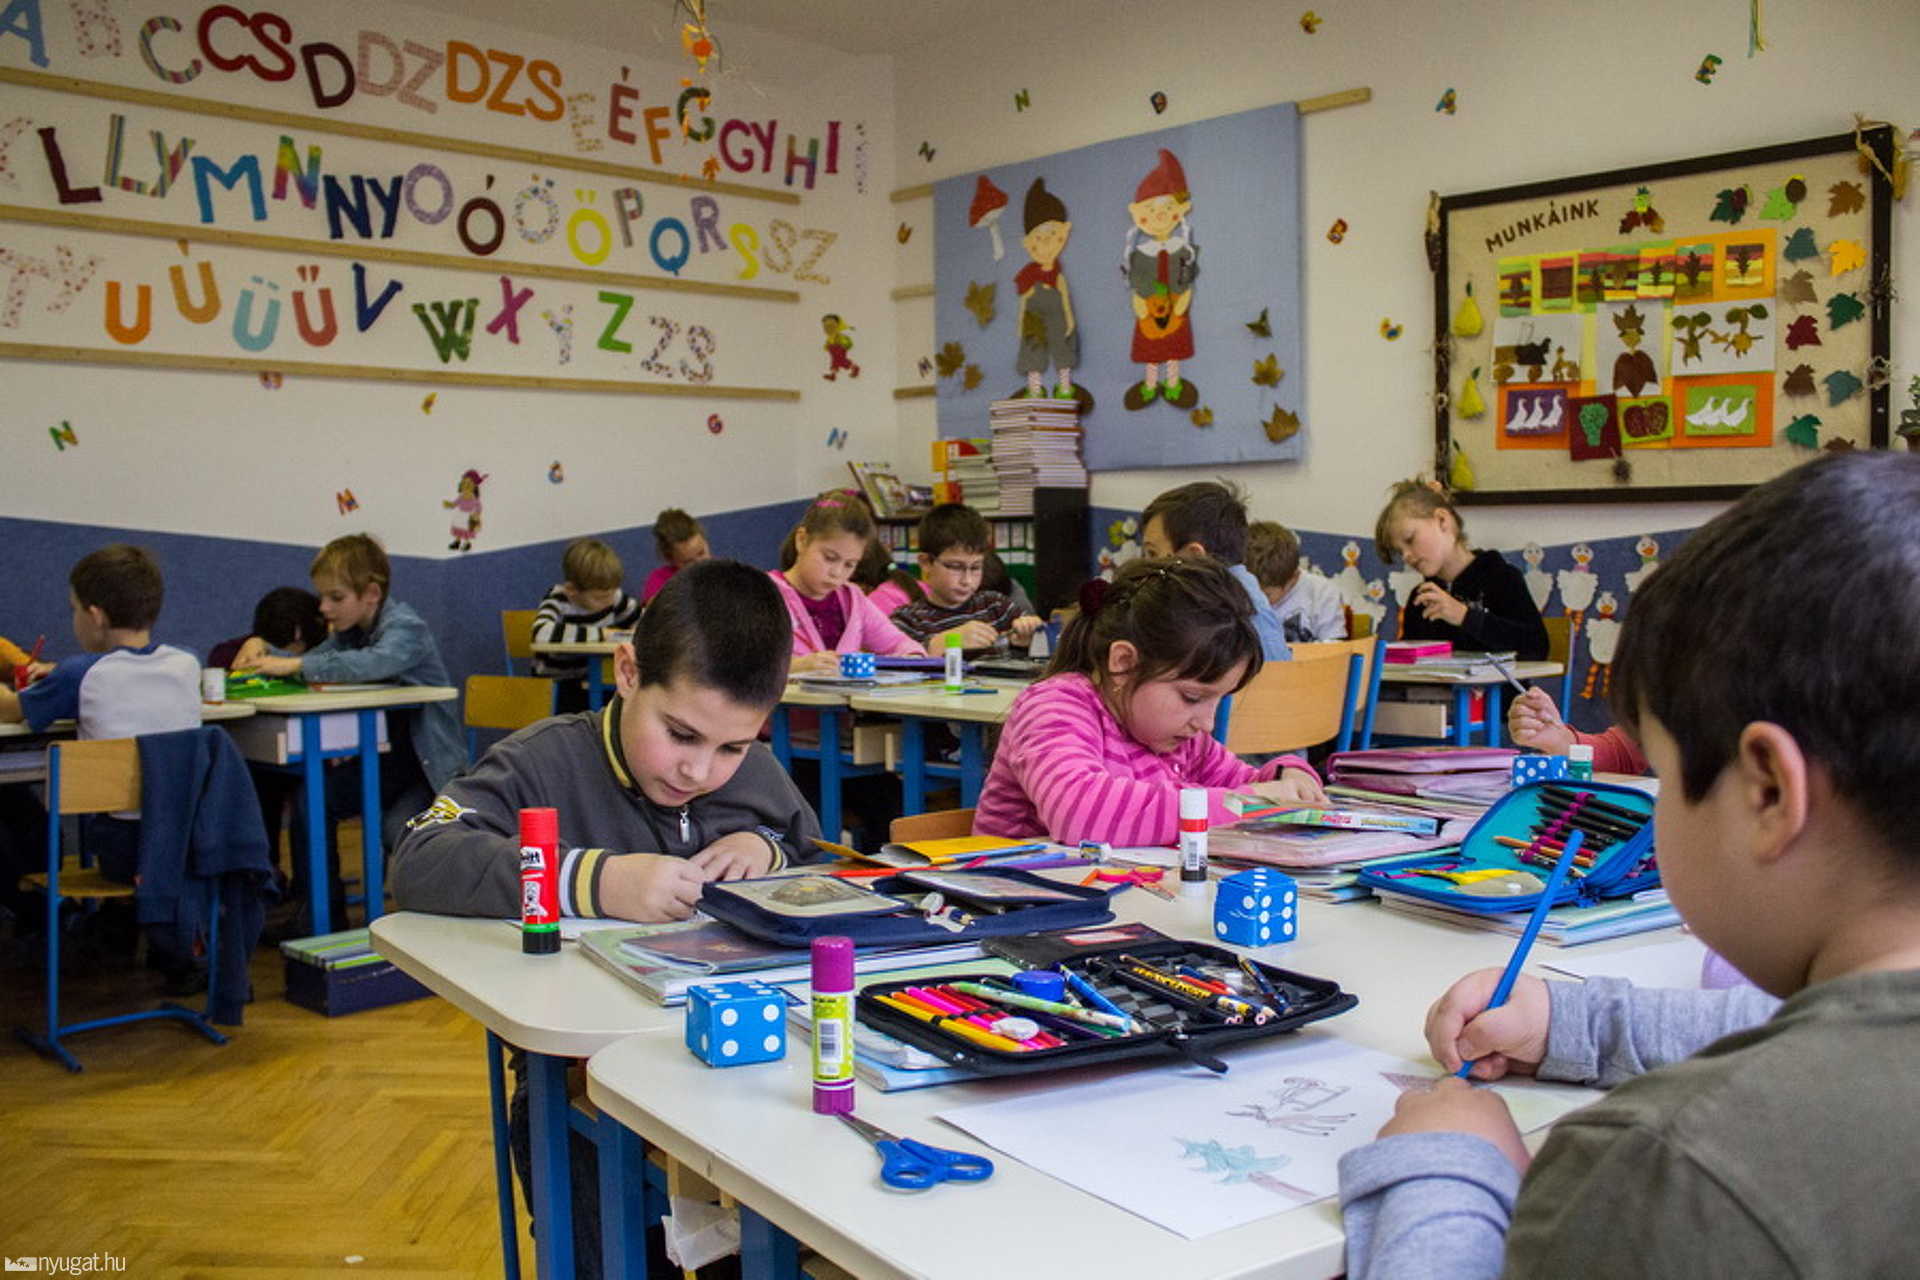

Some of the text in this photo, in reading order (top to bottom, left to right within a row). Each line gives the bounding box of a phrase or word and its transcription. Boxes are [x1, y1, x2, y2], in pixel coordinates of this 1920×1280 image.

[138, 16, 202, 84] C
[197, 4, 296, 82] CS
[301, 42, 356, 108] D
[356, 30, 445, 115] DZ
[446, 40, 566, 122] DZS
[608, 66, 639, 145] É
[643, 105, 671, 165] F
[718, 119, 777, 173] GY
[784, 134, 819, 190] H
[825, 121, 840, 174] I
[38, 127, 102, 204] L
[104, 114, 195, 198] LY
[192, 155, 267, 223] M
[273, 135, 323, 210] N
[323, 175, 403, 239] NY
[402, 163, 454, 225] O
[458, 174, 505, 256] Ó
[613, 187, 643, 248] P
[649, 217, 690, 276] Q
[690, 195, 727, 253] R
[729, 223, 760, 280] S
[763, 219, 838, 285] SZ
[1485, 199, 1599, 253] MUNKÁINK
[105, 281, 152, 345] U
[352, 262, 403, 332] V
[412, 298, 480, 364] W
[486, 276, 534, 345] X
[597, 290, 635, 353] Z
